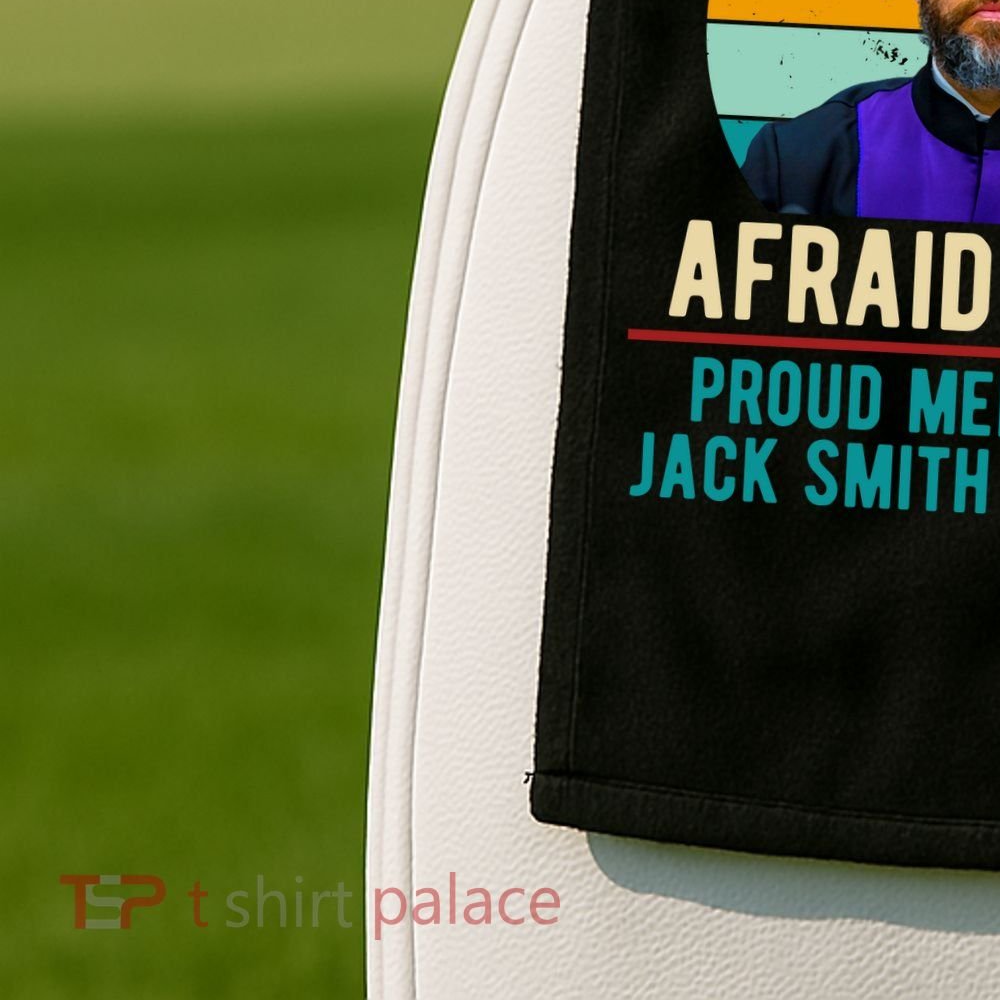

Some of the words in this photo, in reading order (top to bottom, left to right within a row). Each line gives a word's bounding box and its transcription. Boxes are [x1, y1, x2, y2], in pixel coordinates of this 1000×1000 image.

[668, 219, 992, 332] AFRAID
[690, 356, 882, 431] PROUD
[629, 431, 778, 504] JACK
[804, 439, 990, 514] SMITH
